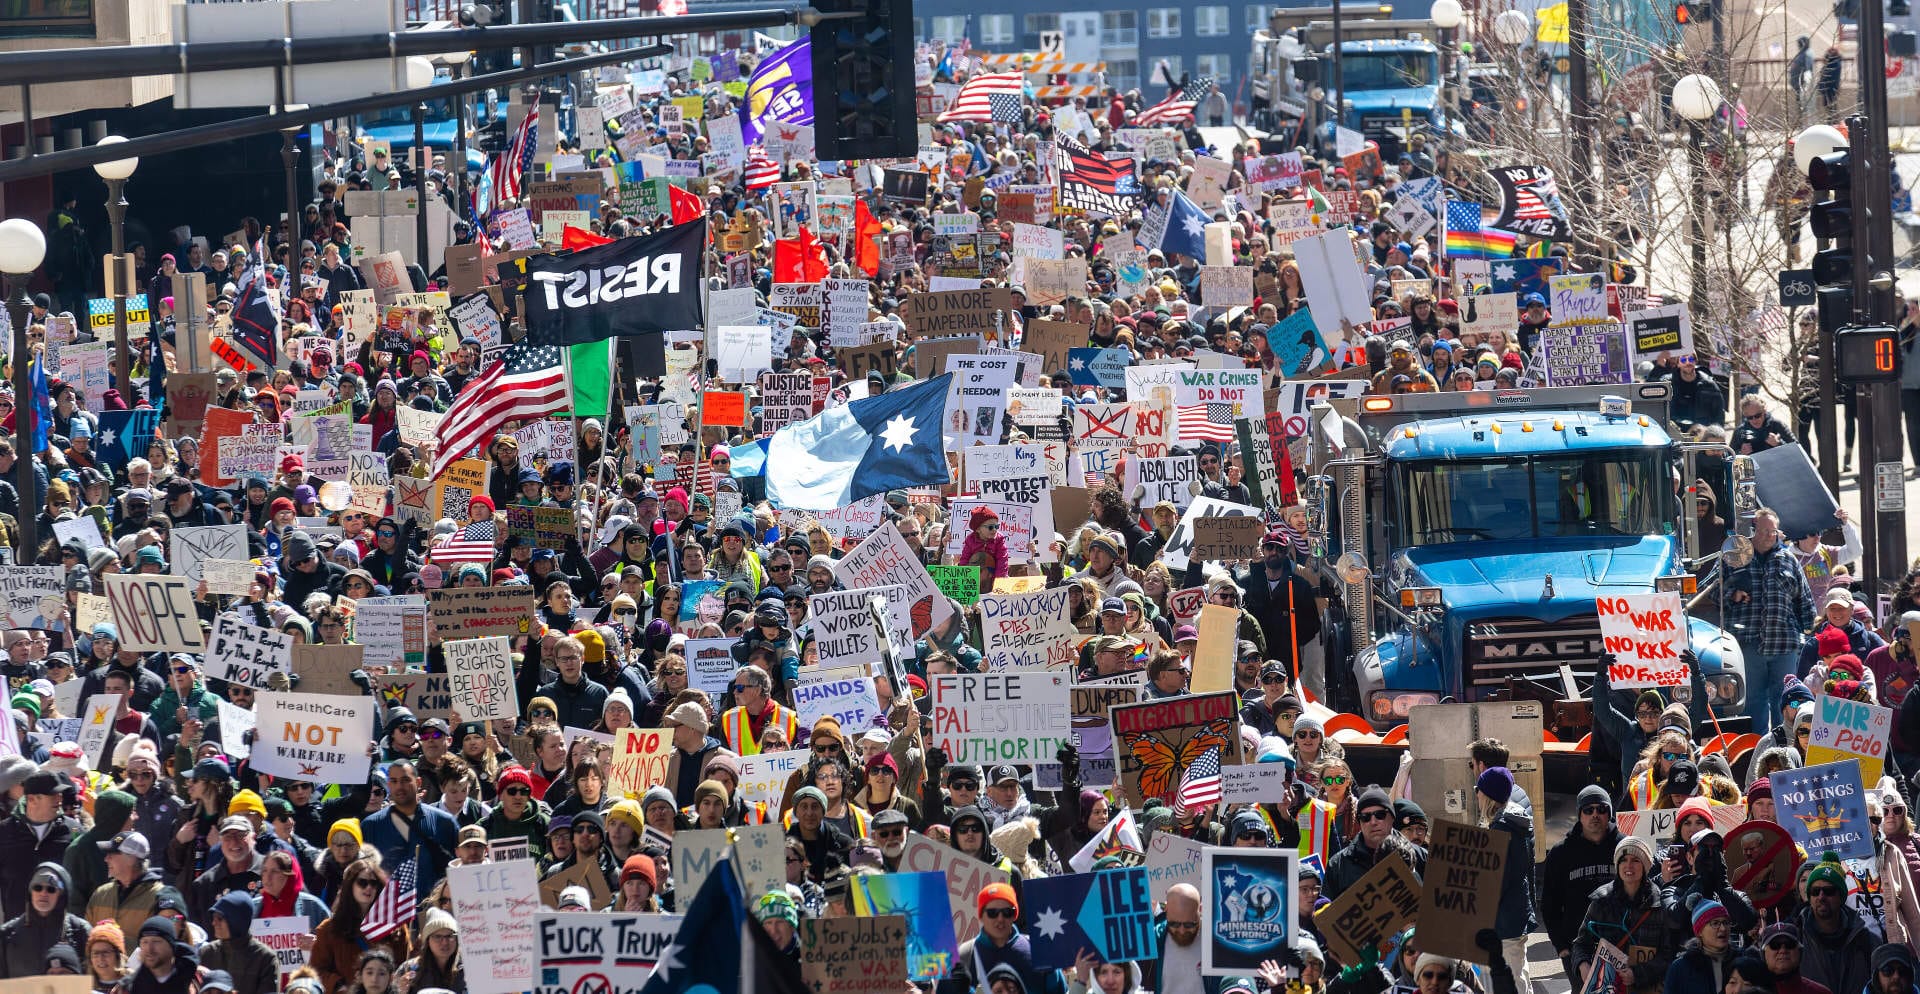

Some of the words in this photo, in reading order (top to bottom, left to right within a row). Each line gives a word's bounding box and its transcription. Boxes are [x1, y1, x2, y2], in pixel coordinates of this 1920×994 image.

[825, 280, 839, 290] NO
[843, 282, 867, 292] MORE
[782, 296, 812, 305] STAND
[914, 296, 938, 313] NO
[945, 292, 992, 309] MORE
[92, 314, 114, 326] ICE
[1546, 329, 1573, 337] DEARLY
[1583, 325, 1619, 335] BELOVED
[1555, 336, 1570, 346] WE
[1577, 335, 1593, 345] ARE
[1652, 337, 1665, 345] Big
[1551, 346, 1595, 356] GATHERED
[1875, 338, 1893, 372] 10
[957, 360, 975, 369] THE
[980, 360, 1007, 369] COST
[1552, 365, 1578, 376] START
[1583, 365, 1600, 374] THE
[765, 374, 811, 390] JUSTICE
[971, 374, 984, 383] OF
[1180, 372, 1214, 385] WAR
[1219, 372, 1258, 385] CRIMES
[790, 395, 811, 406] GOOD
[1199, 388, 1214, 400] DO
[1221, 387, 1245, 400] NOT
[764, 409, 789, 419] KILLED
[515, 421, 546, 442] POWER
[764, 421, 774, 432] BY
[661, 433, 684, 443] Hell
[351, 455, 372, 470] NO
[1015, 450, 1036, 467] King
[351, 472, 388, 486] KINGS
[1139, 460, 1195, 482] ABOLISH
[983, 476, 1049, 494] PROTECT
[1158, 482, 1179, 504] ICE
[1005, 490, 1040, 503] KIDS
[999, 507, 1017, 521] the
[1216, 532, 1234, 542] IS
[844, 553, 868, 575] THE
[867, 527, 893, 556] ONLY
[1197, 545, 1255, 557] STINKY
[853, 544, 905, 589] ORANGE
[935, 567, 971, 577] TRUMP
[431, 591, 454, 602] Why
[454, 592, 470, 600] are
[475, 590, 494, 601] eggs
[107, 581, 200, 646] NOPE
[434, 608, 452, 617] cuz
[457, 606, 472, 614] all
[474, 605, 487, 614] the
[490, 606, 527, 614] chickens
[983, 592, 1067, 620] DEMOCRACY
[1597, 597, 1629, 616] NO
[463, 617, 517, 629] CONGRESS
[820, 611, 872, 634] WORDS
[1000, 617, 1030, 634] DIES
[1035, 616, 1048, 629] IN
[1629, 609, 1675, 632] WAR
[218, 619, 236, 637] For
[239, 625, 256, 642] The
[259, 630, 285, 650] People
[215, 639, 232, 661] By
[235, 644, 251, 661] The
[253, 650, 279, 673] People
[450, 641, 499, 657] HUMAN
[819, 634, 868, 660] BULLETS
[987, 652, 1008, 667] WE
[1011, 651, 1045, 666] WILL
[1047, 639, 1072, 665] NOT
[1605, 636, 1634, 654] NO
[1636, 640, 1677, 660] KKK
[457, 654, 505, 672] RIGHTS
[224, 664, 250, 681] NO
[453, 671, 506, 692] BELONG
[1608, 664, 1635, 682] NO
[1637, 664, 1691, 683] Fascist
[794, 680, 865, 703] HANDS
[937, 676, 1022, 704] FREE
[276, 700, 356, 718] HealthCare
[471, 702, 499, 718] ONE
[833, 709, 865, 726] OFF
[1118, 694, 1231, 733] MIGRATION
[1822, 696, 1870, 731] WAR
[1874, 712, 1886, 726] is
[935, 703, 1067, 735] PALESTINE
[283, 721, 343, 746] NOT
[1834, 729, 1882, 756] Pedo
[626, 732, 660, 754] NO
[941, 737, 1068, 765] AUTHORITY
[276, 746, 346, 764] WARFARE
[766, 758, 797, 771] THE
[1782, 790, 1805, 806] NO
[1808, 783, 1855, 802] KINGS
[1650, 812, 1671, 836] NO
[1445, 825, 1490, 851] FUND
[1807, 832, 1861, 849] AMERICA
[1431, 838, 1501, 873] MEDICAID
[1448, 866, 1480, 888] NOT
[1597, 865, 1609, 874] THE
[472, 868, 513, 893] ICE
[1099, 868, 1148, 915] ICE
[1356, 882, 1377, 911] IS
[1375, 911, 1388, 930] A
[1434, 886, 1478, 916] WAR
[1855, 895, 1884, 908] NO
[822, 919, 849, 944] for
[853, 919, 890, 945] Jobs
[1218, 921, 1282, 933] MINNESOTA
[1228, 931, 1270, 940] STRONG
[540, 918, 603, 956] FUCK
[1103, 913, 1152, 962] OUT
[885, 945, 906, 961] not
[824, 964, 847, 979] for
[859, 960, 900, 976] WAR
